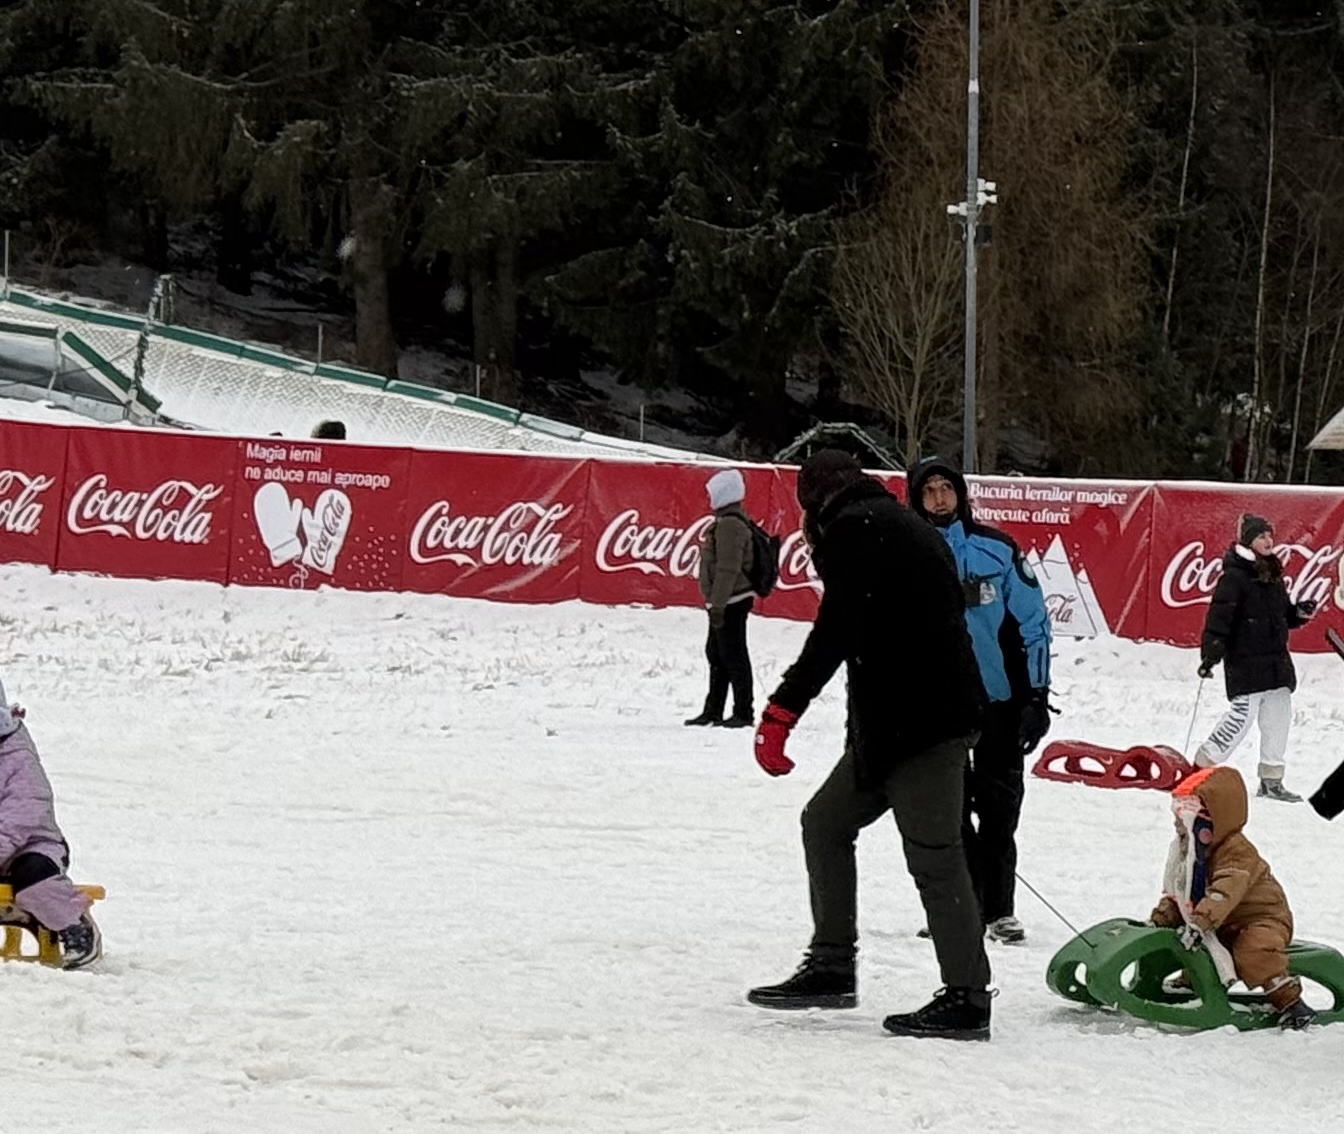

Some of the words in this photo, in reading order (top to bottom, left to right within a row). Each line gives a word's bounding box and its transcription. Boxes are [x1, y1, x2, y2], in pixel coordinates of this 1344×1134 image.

[246, 442, 287, 464] Magia
[244, 466, 261, 480] ne
[264, 466, 304, 483] aduce
[306, 468, 332, 485] mai
[334, 472, 391, 491] aproape
[970, 482, 1023, 500] Bucuria
[1076, 489, 1128, 507] magice
[67, 474, 224, 544] Coca-Cola
[1032, 507, 1070, 524] afară
[410, 501, 574, 566] Coca-Cola
[1207, 714, 1246, 754] YORK
